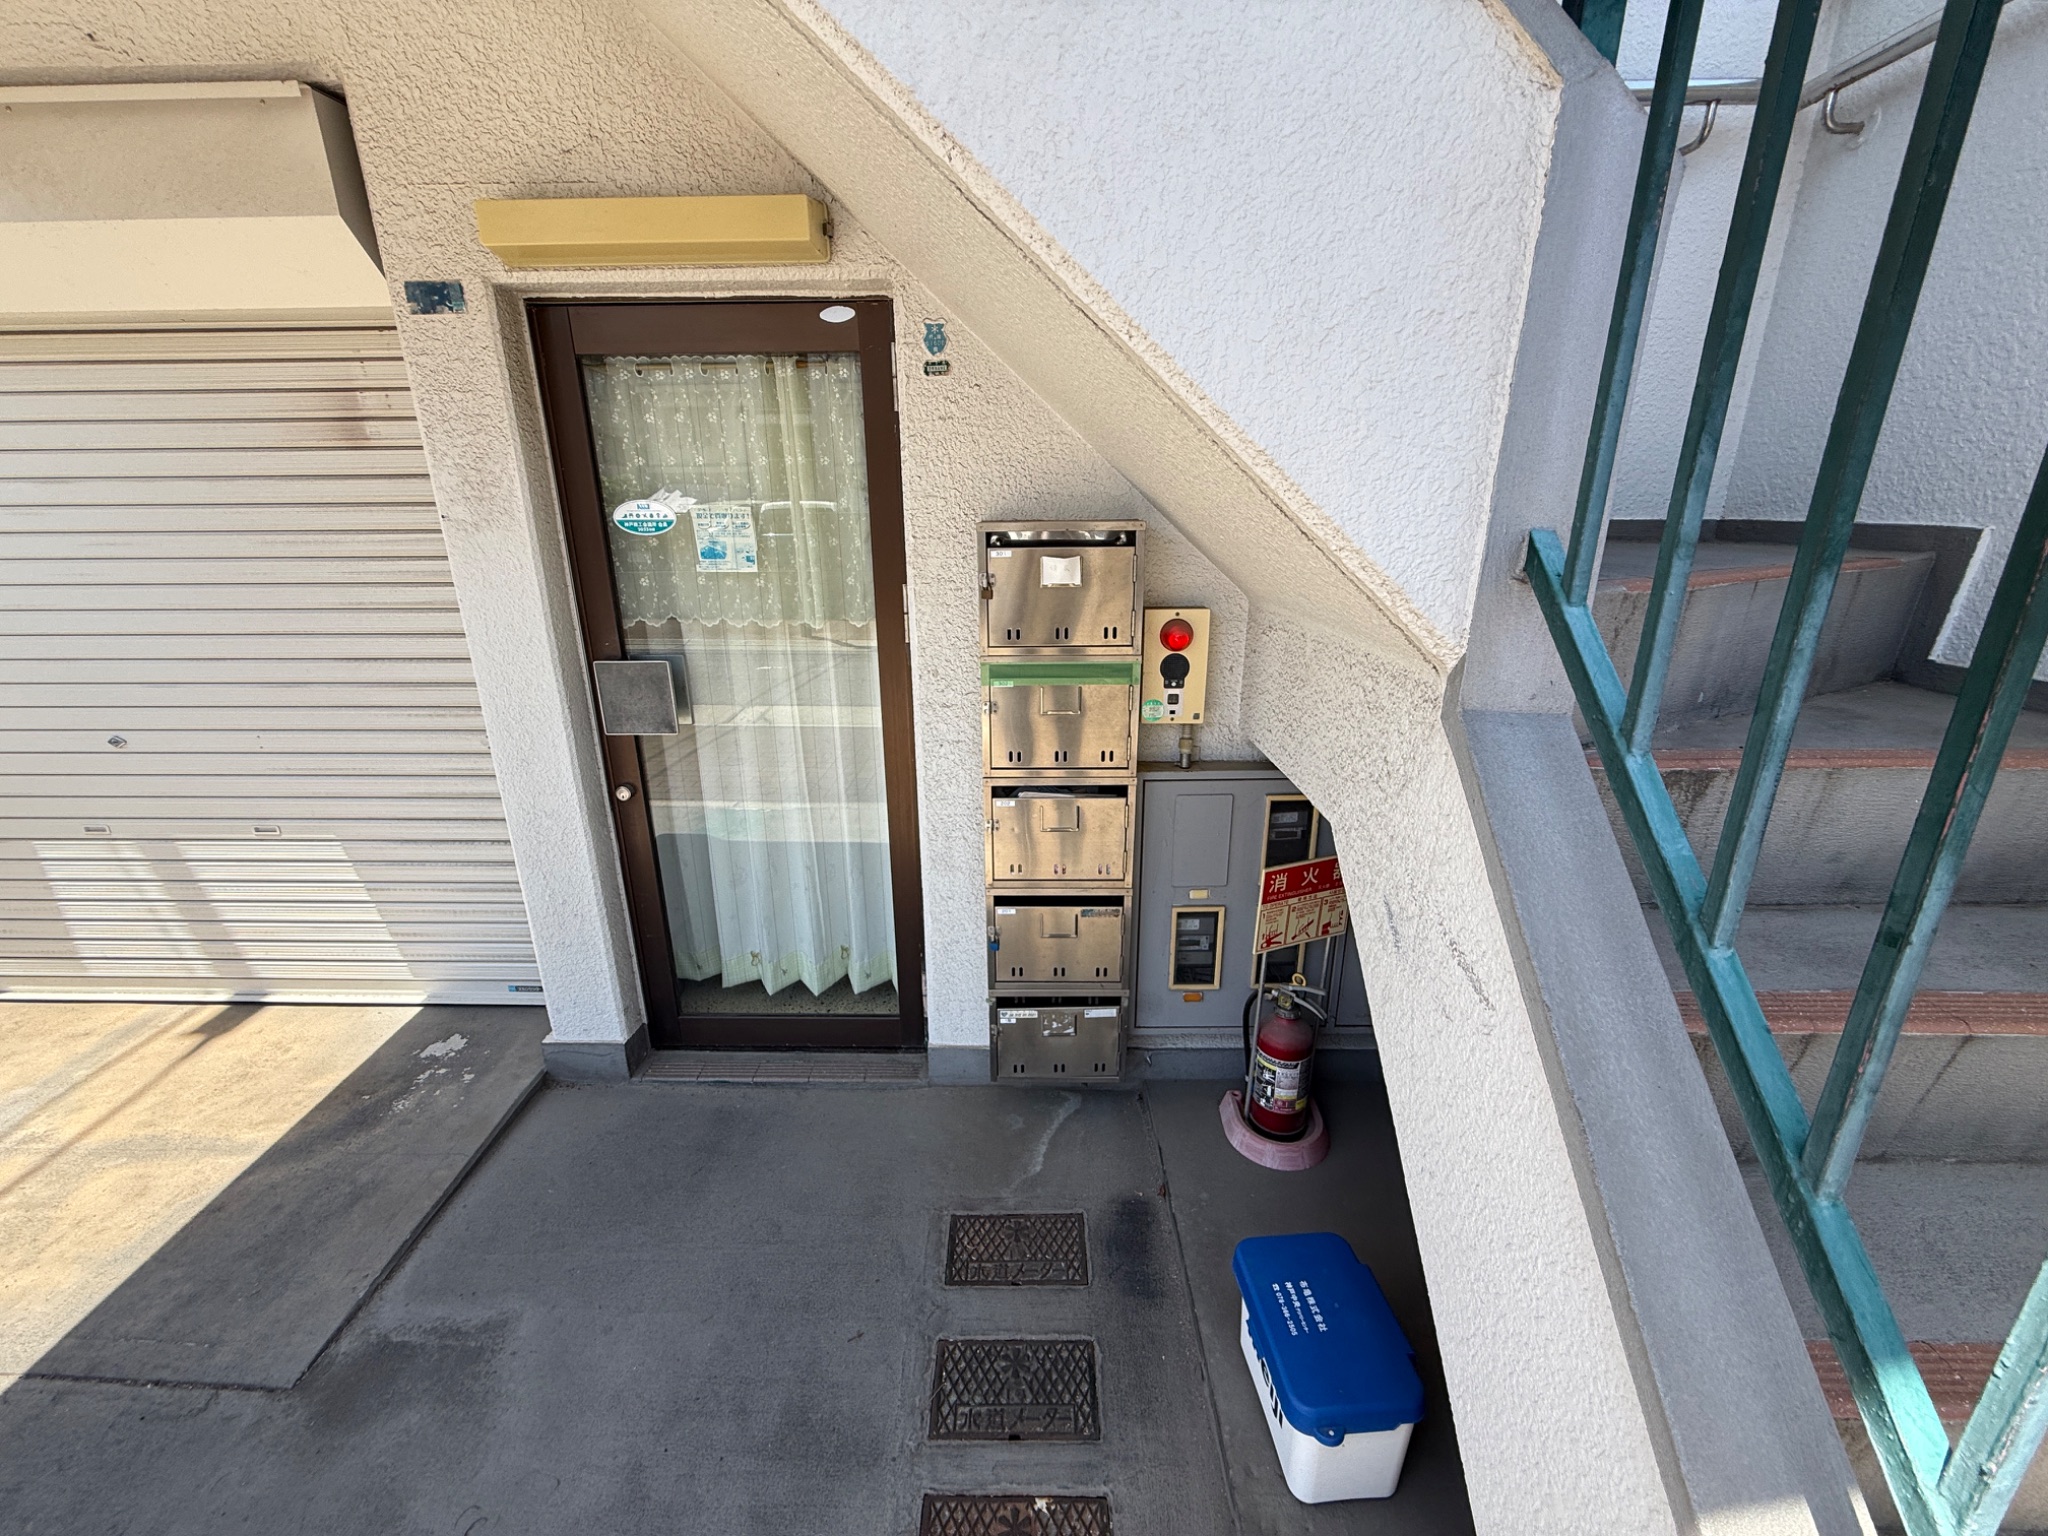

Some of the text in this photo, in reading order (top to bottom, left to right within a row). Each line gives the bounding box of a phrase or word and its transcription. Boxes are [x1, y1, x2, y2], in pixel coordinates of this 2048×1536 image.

[968, 1264, 1067, 1281] 水道メーター
[957, 1407, 1072, 1430] 水道メーター
